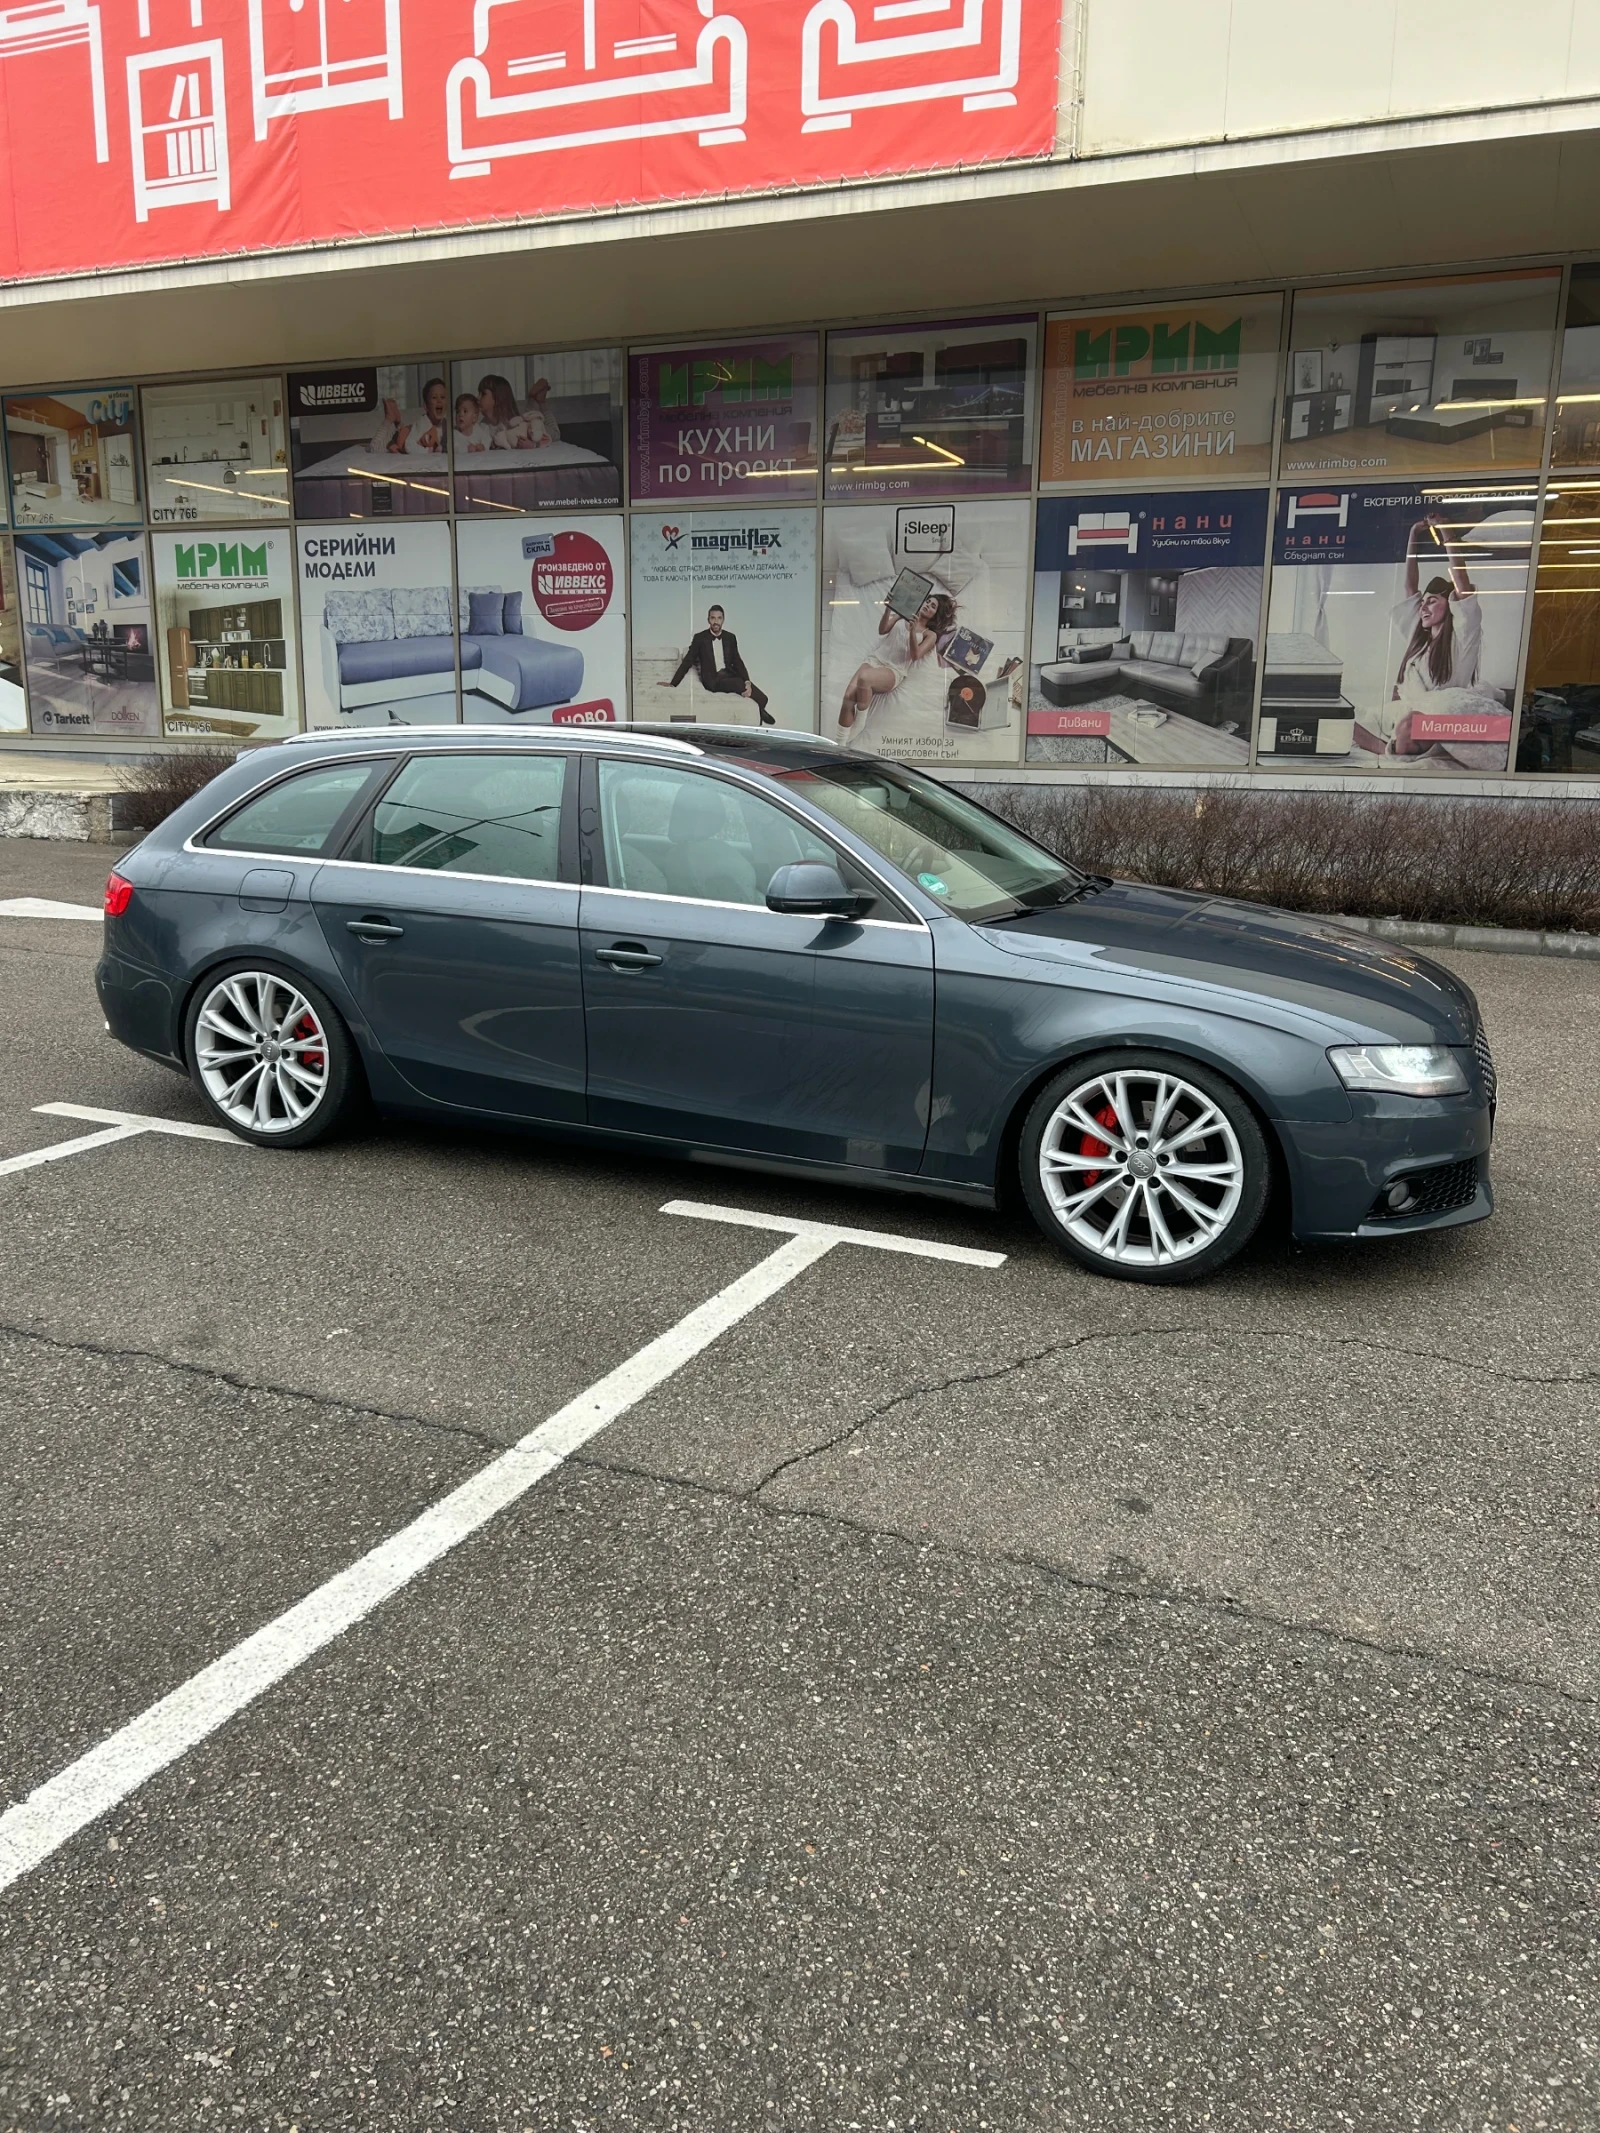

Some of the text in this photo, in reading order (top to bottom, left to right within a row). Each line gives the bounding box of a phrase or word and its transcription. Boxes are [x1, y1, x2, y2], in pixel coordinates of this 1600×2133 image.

[1075, 317, 1242, 379] ИРИМ
[659, 352, 793, 408] ИРИМ
[316, 382, 365, 399] ИВВЕКС
[1073, 377, 1238, 399] мебелна компания
[86, 399, 130, 426] City
[1091, 408, 1236, 432] най-добрите
[637, 358, 651, 495] www.irimbg.com
[678, 424, 775, 456] КУХНИ
[1070, 430, 1236, 463] МАГАЗИНИ
[1286, 456, 1387, 471] www.irimbg.com
[659, 458, 797, 486] по проект
[829, 480, 910, 492] www.irimbg.com
[538, 497, 619, 507] www.mebeli-ivveks.com
[1364, 497, 1413, 507] ЕКСПЕРТИ
[1415, 496, 1422, 505] В
[16, 513, 54, 524] CITY 266
[152, 507, 198, 521] CITY 766
[904, 521, 948, 536] iSleep
[304, 533, 396, 557] СЕРИЙНИ
[691, 528, 782, 551] magniflex
[526, 544, 551, 554] СКЛАД
[1284, 551, 1326, 561] Сбъднат
[174, 541, 268, 578] ИРИМ
[305, 561, 376, 580] МОДЕЛИ
[537, 562, 607, 573] ПРОИЗВЕДЕНО ОТ
[177, 581, 269, 591] мебелна компания
[554, 575, 607, 589] ИВВЕКС
[53, 713, 91, 725] Tarkett
[167, 721, 190, 732] CITY
[1057, 716, 1102, 729] Дивани
[1421, 720, 1488, 735] Матраци
[881, 736, 954, 748] Умният избор за
[940, 749, 959, 759] сън!
